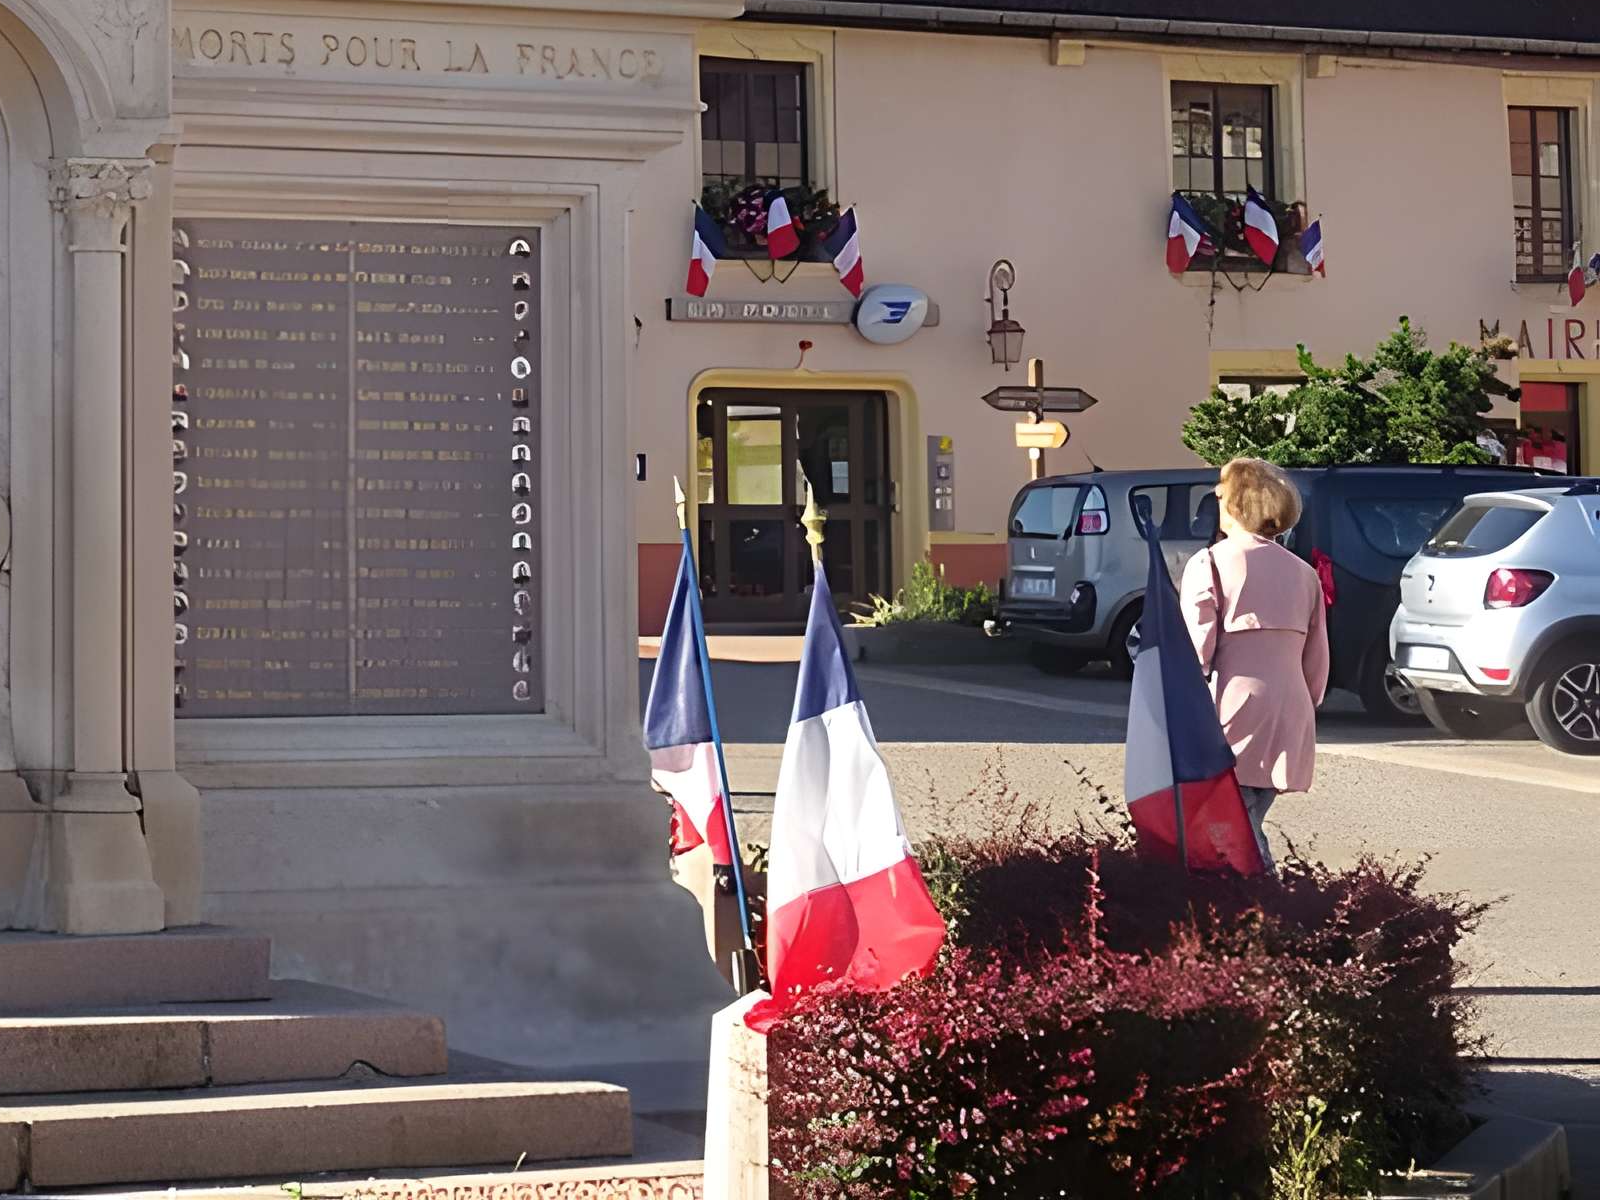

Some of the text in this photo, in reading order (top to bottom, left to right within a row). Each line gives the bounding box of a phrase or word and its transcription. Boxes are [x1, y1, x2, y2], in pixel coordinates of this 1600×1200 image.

[171, 26, 296, 66] MORTS
[319, 33, 421, 72] POUR
[442, 39, 490, 74] LA
[1478, 317, 1600, 360] MAIR
